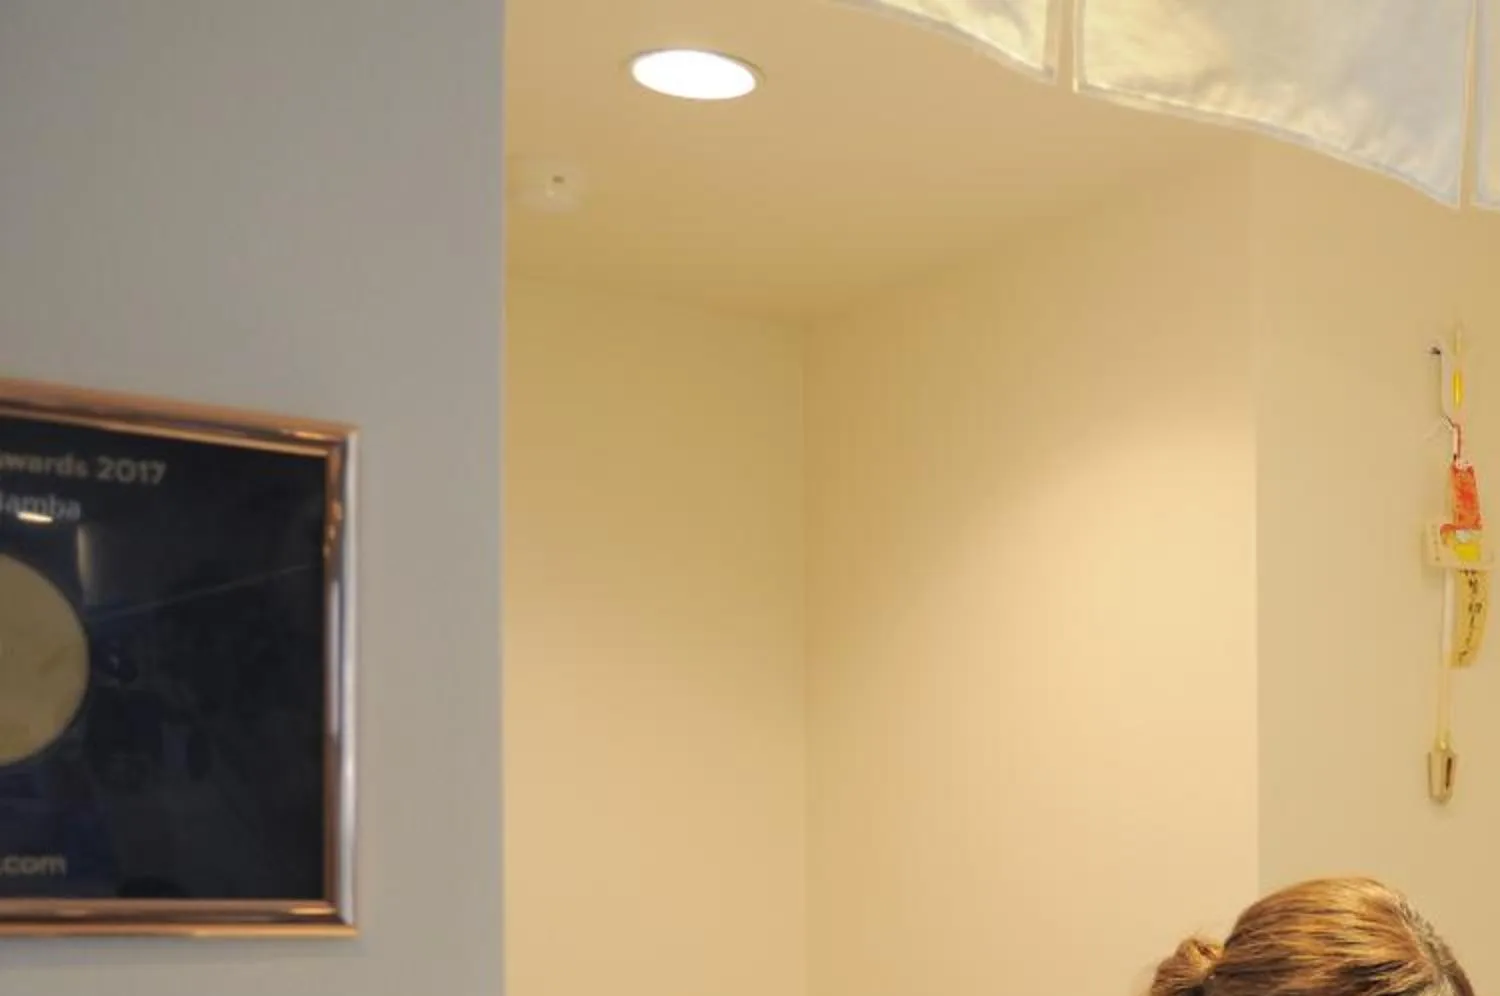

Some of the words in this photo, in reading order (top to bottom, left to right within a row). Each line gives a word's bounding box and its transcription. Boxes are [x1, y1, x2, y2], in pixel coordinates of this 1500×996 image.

[0, 452, 89, 479] wards
[97, 455, 168, 485] 2017
[0, 492, 82, 521] amba
